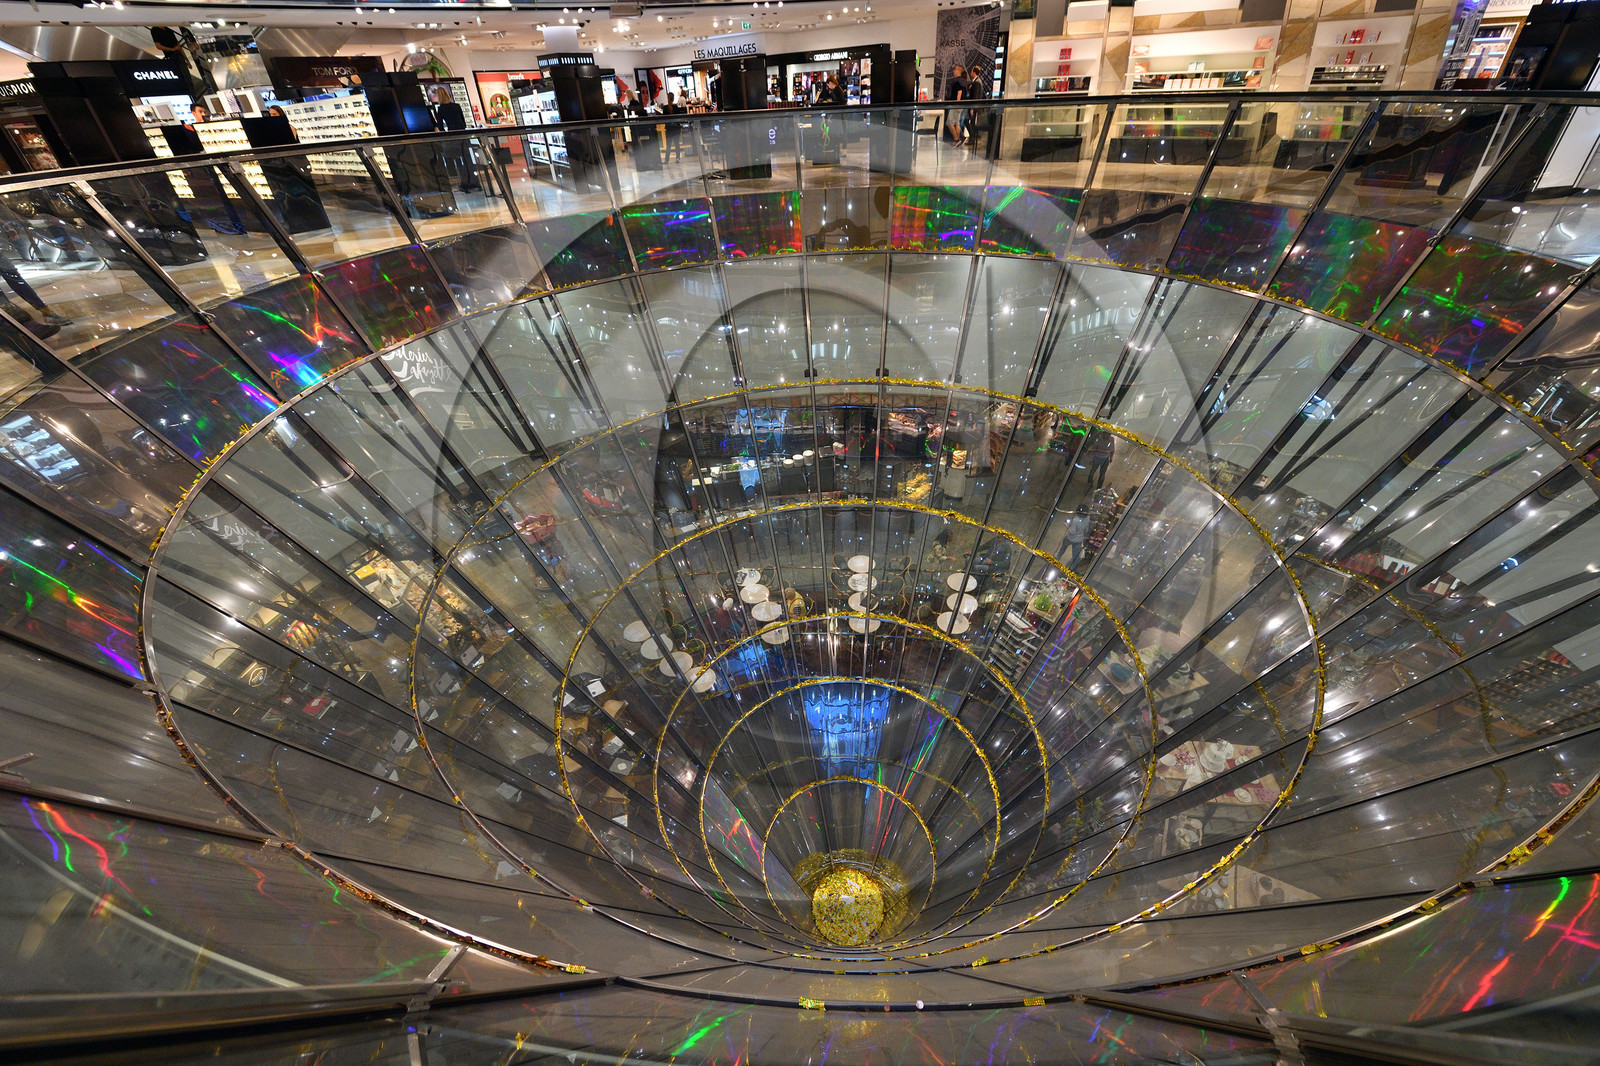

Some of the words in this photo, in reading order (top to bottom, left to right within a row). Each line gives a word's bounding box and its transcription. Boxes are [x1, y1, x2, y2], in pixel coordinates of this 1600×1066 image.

[940, 39, 966, 48] KASSE
[694, 49, 706, 59] LES
[707, 43, 757, 58] MAQUILLAGES
[133, 70, 179, 81] CHANEL
[312, 67, 334, 76] TOM
[333, 66, 358, 76] FORD
